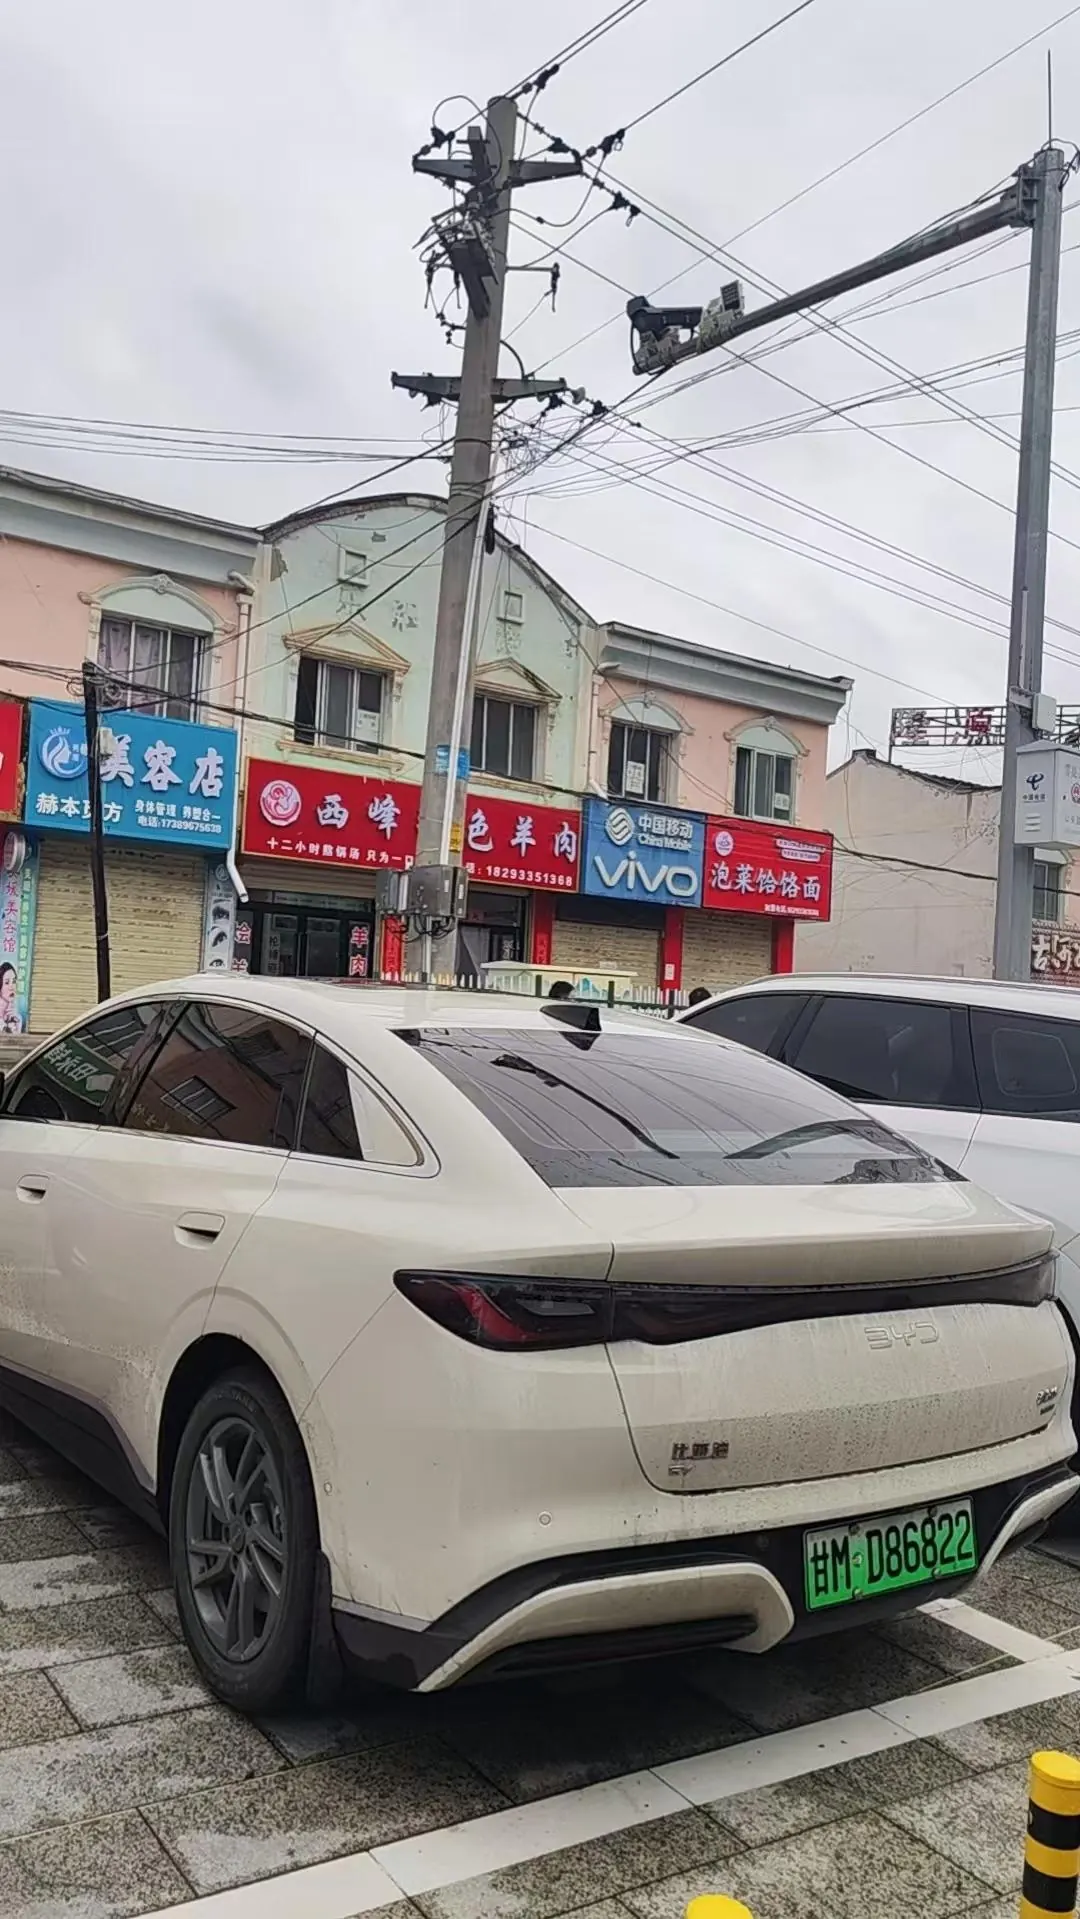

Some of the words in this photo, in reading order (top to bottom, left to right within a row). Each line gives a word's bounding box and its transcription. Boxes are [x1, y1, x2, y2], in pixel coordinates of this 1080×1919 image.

[99, 734, 224, 798] 美容店
[135, 799, 177, 818] 身体管理
[317, 793, 577, 863] 西峰色羊肉
[638, 813, 693, 838] 中国移动
[638, 833, 663, 848] China
[664, 837, 692, 853] Mobile
[711, 861, 821, 902] 泡菜饸饹面
[349, 926, 369, 976] 羊肉
[864, 1321, 939, 1350] BYD
[671, 1441, 730, 1461] 比亚迪
